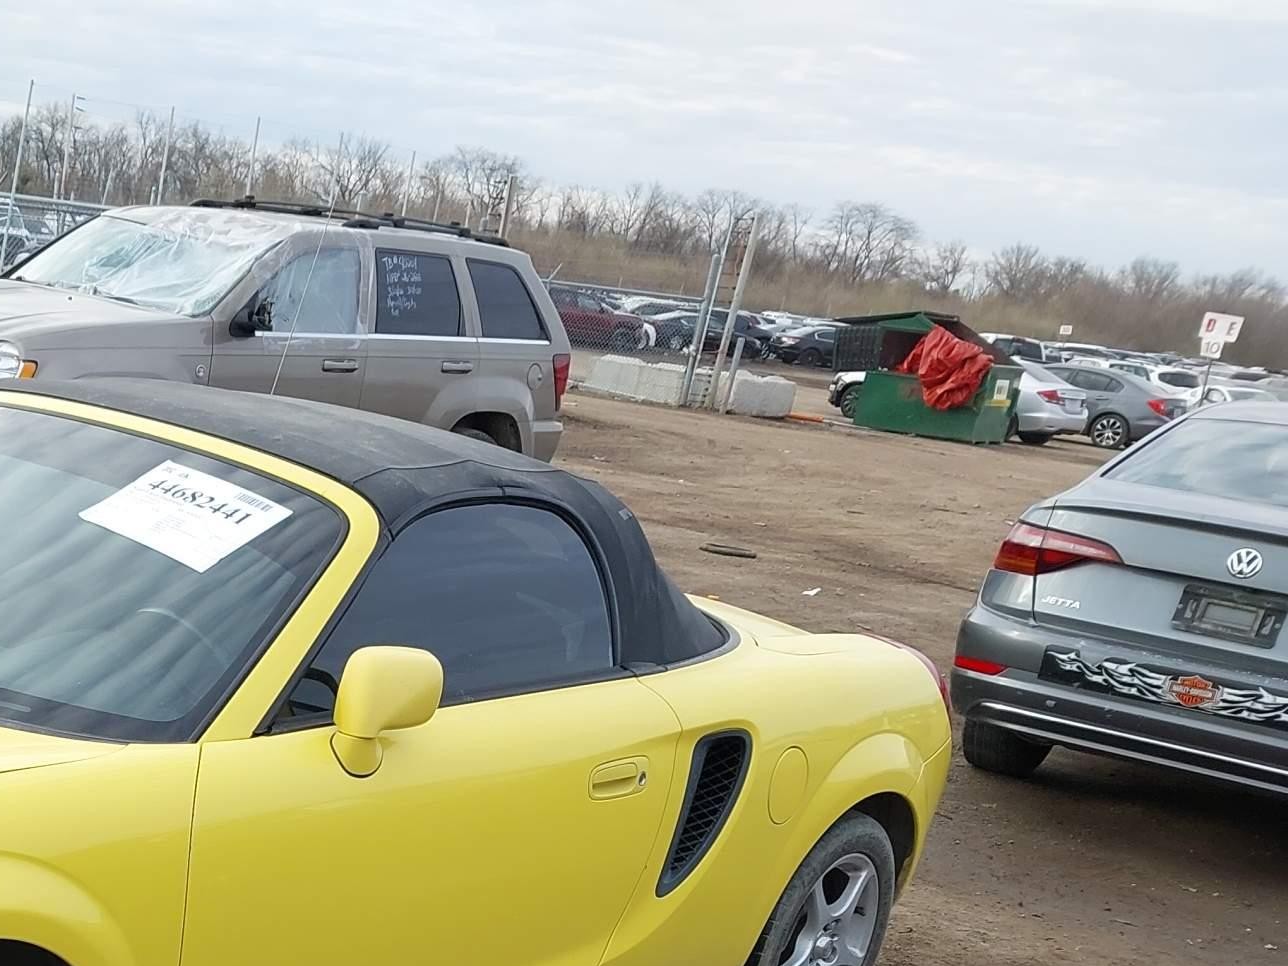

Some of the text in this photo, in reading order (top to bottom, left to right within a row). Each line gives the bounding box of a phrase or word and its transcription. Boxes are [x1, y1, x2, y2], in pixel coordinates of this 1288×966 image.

[1226, 321, 1238, 336] E
[1204, 341, 1221, 354] 10
[148, 480, 253, 525] 44682441
[1041, 595, 1081, 609] JETTA
